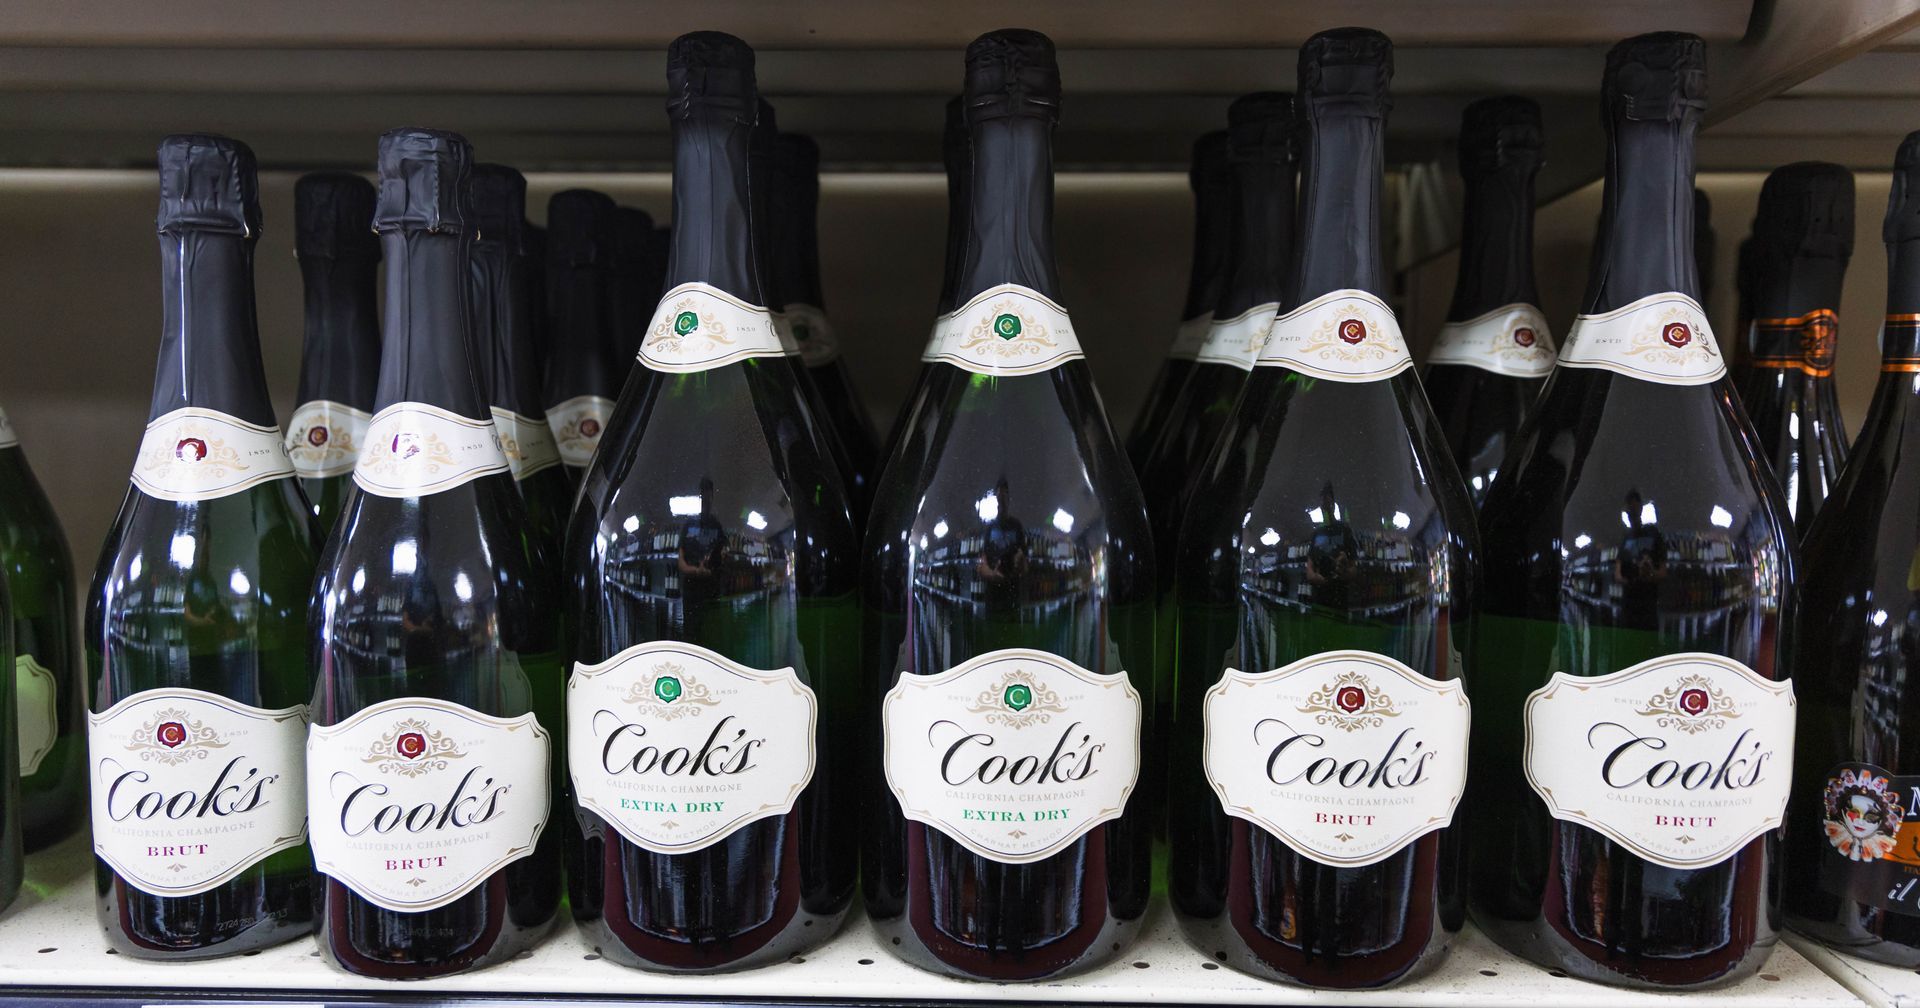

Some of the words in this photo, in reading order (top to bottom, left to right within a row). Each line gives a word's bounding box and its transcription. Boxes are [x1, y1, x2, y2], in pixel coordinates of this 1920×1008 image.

[593, 709, 762, 777] Cook's
[928, 719, 1104, 787] Cook's
[1253, 717, 1436, 789] Cook's
[1587, 721, 1772, 791] Cook's
[99, 755, 277, 822] Cook's
[606, 778, 667, 793] CALIFORNIA
[671, 783, 742, 794] CHAMPAGNE
[330, 765, 510, 837] Cook's
[945, 790, 1015, 803] CALIFORNIA
[1018, 788, 1087, 802] CHAMPAGNE
[1270, 788, 1344, 806] CALIFORNIA
[1606, 792, 1685, 809] CALIFORNIA
[620, 798, 679, 813] EXTRA
[686, 801, 725, 813] DRY
[963, 808, 1026, 822] EXTRA
[1034, 808, 1071, 822] DRY
[1315, 812, 1376, 826] BRUT
[1655, 814, 1717, 828] BRUT
[176, 820, 256, 837] CHAMPAGNE
[346, 840, 413, 851] CALIFORNIA
[416, 831, 491, 849] CHAMPAGNE
[147, 843, 208, 857] BRUT
[385, 855, 447, 871] BRUT
